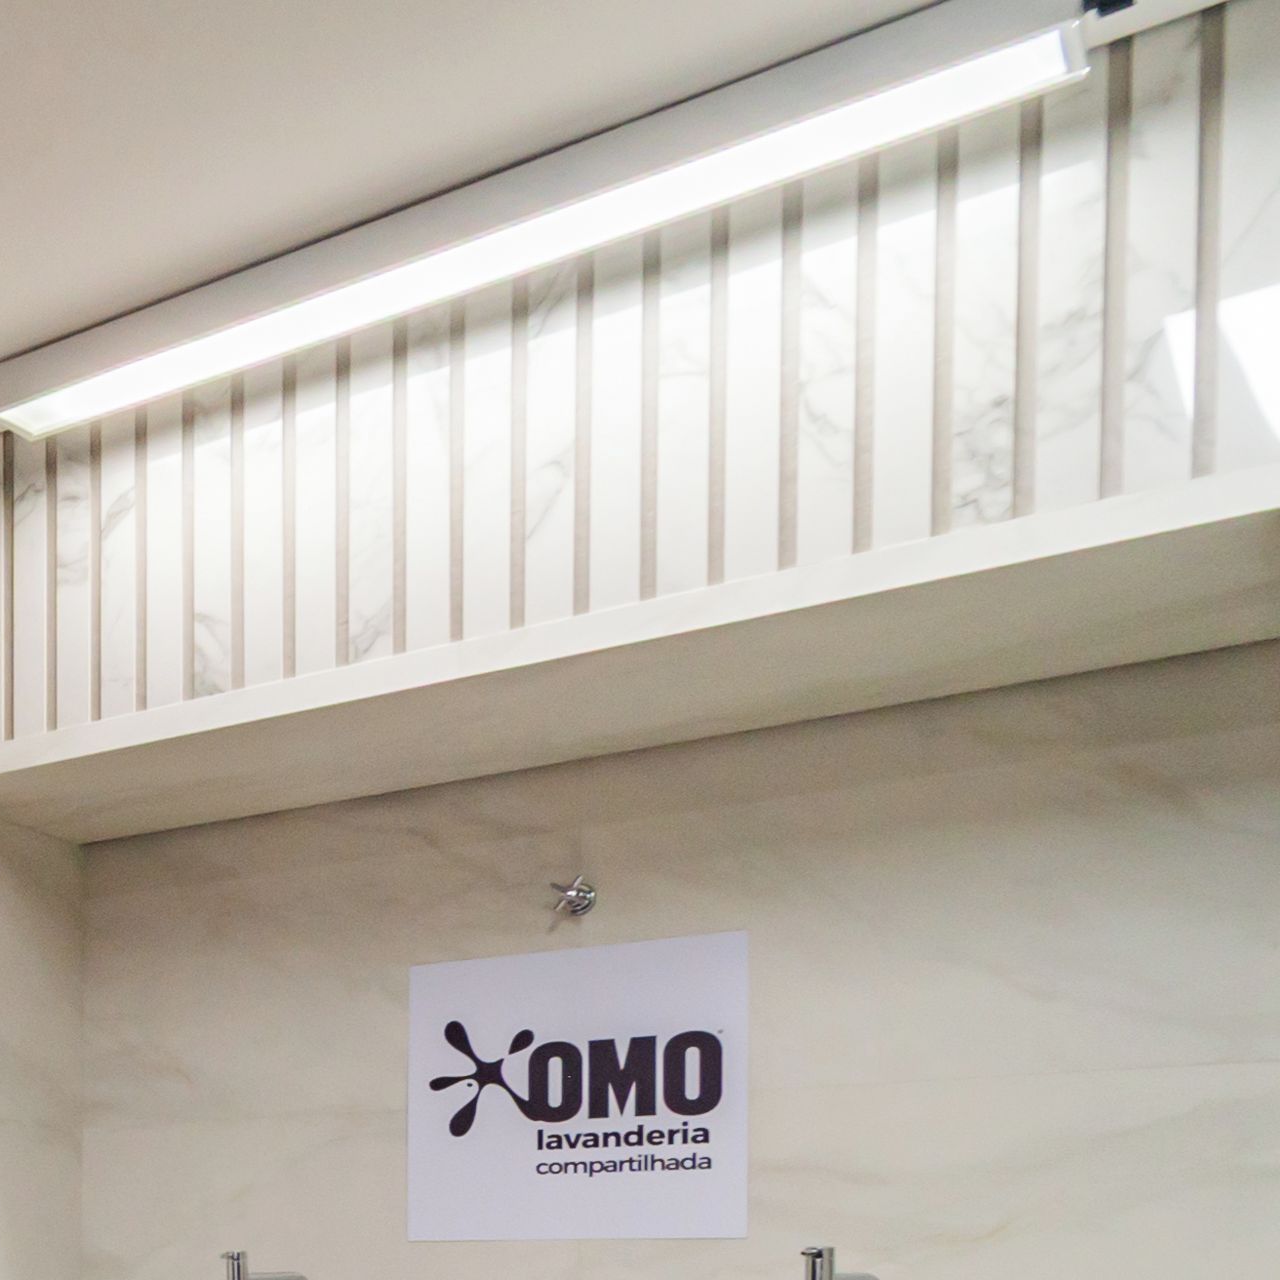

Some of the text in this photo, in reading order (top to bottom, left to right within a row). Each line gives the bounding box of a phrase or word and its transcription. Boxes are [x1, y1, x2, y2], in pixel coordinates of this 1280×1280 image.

[528, 1030, 722, 1122] OMO
[537, 1122, 709, 1150] lavanderia
[536, 1152, 711, 1177] compartilhada
